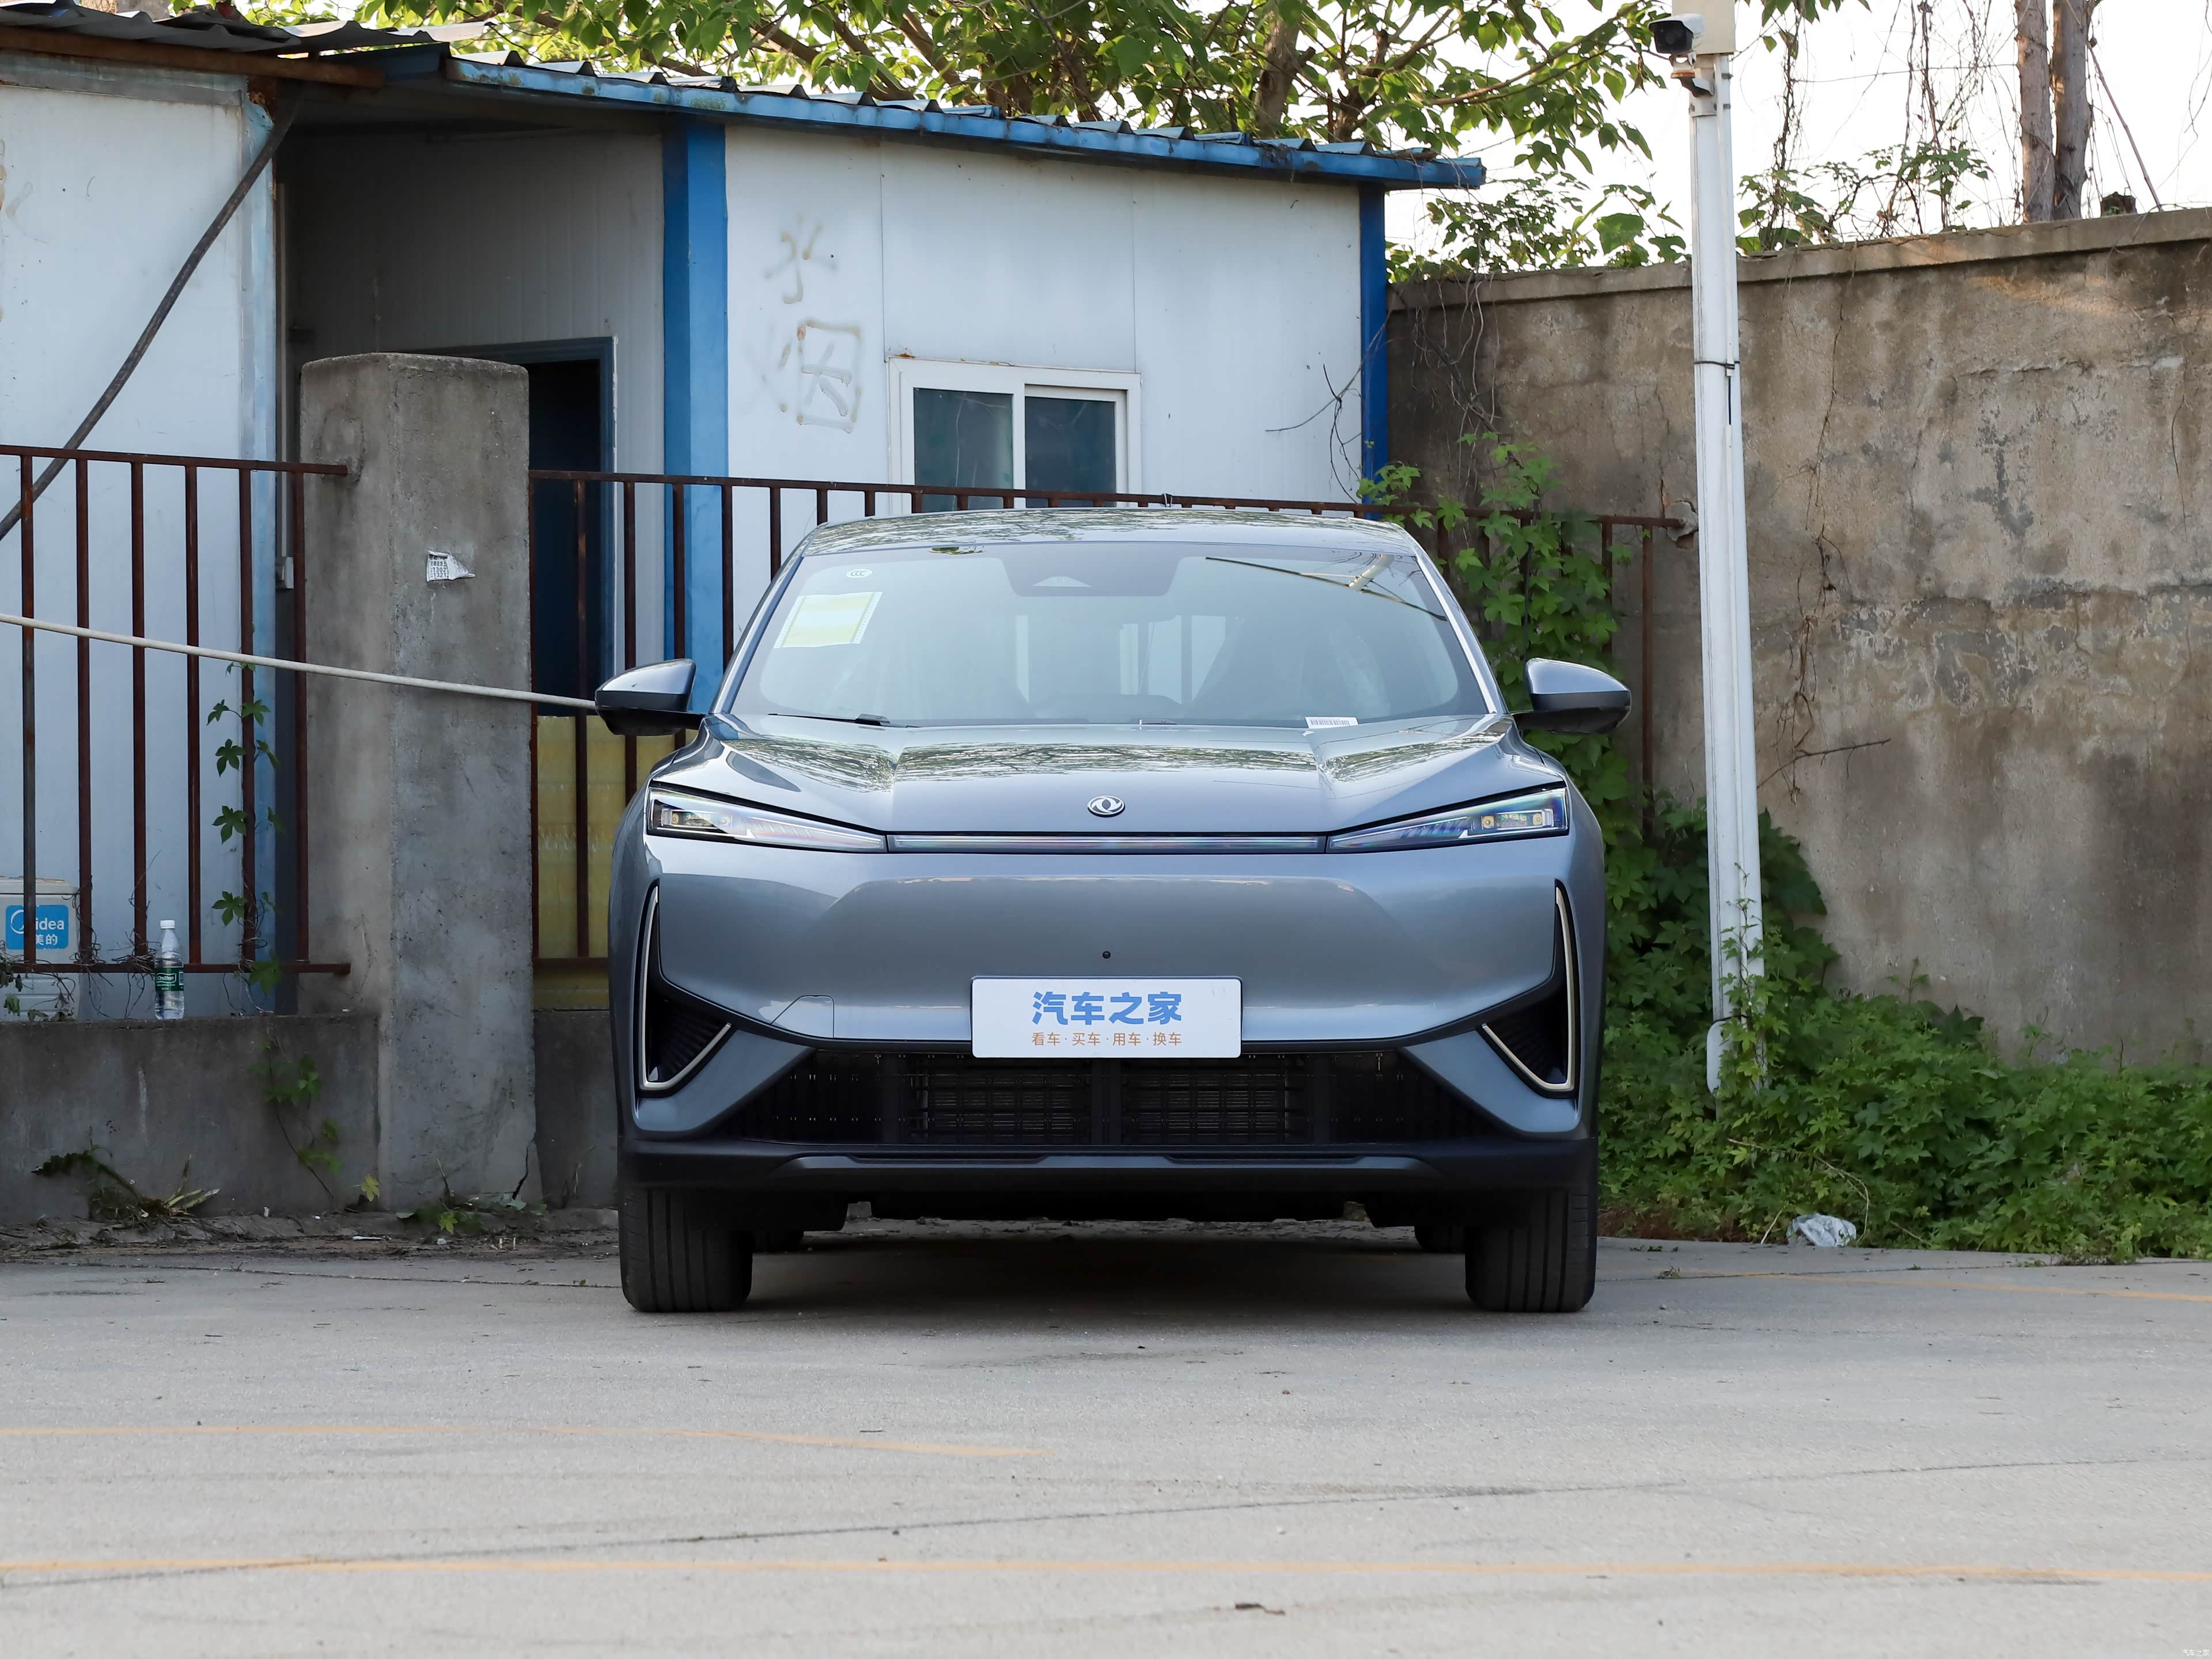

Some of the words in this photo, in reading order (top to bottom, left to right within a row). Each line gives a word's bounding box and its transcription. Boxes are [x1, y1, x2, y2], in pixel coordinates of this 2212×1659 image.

[35, 934, 58, 945] 美的
[1032, 991, 1182, 1025] 汽车之家
